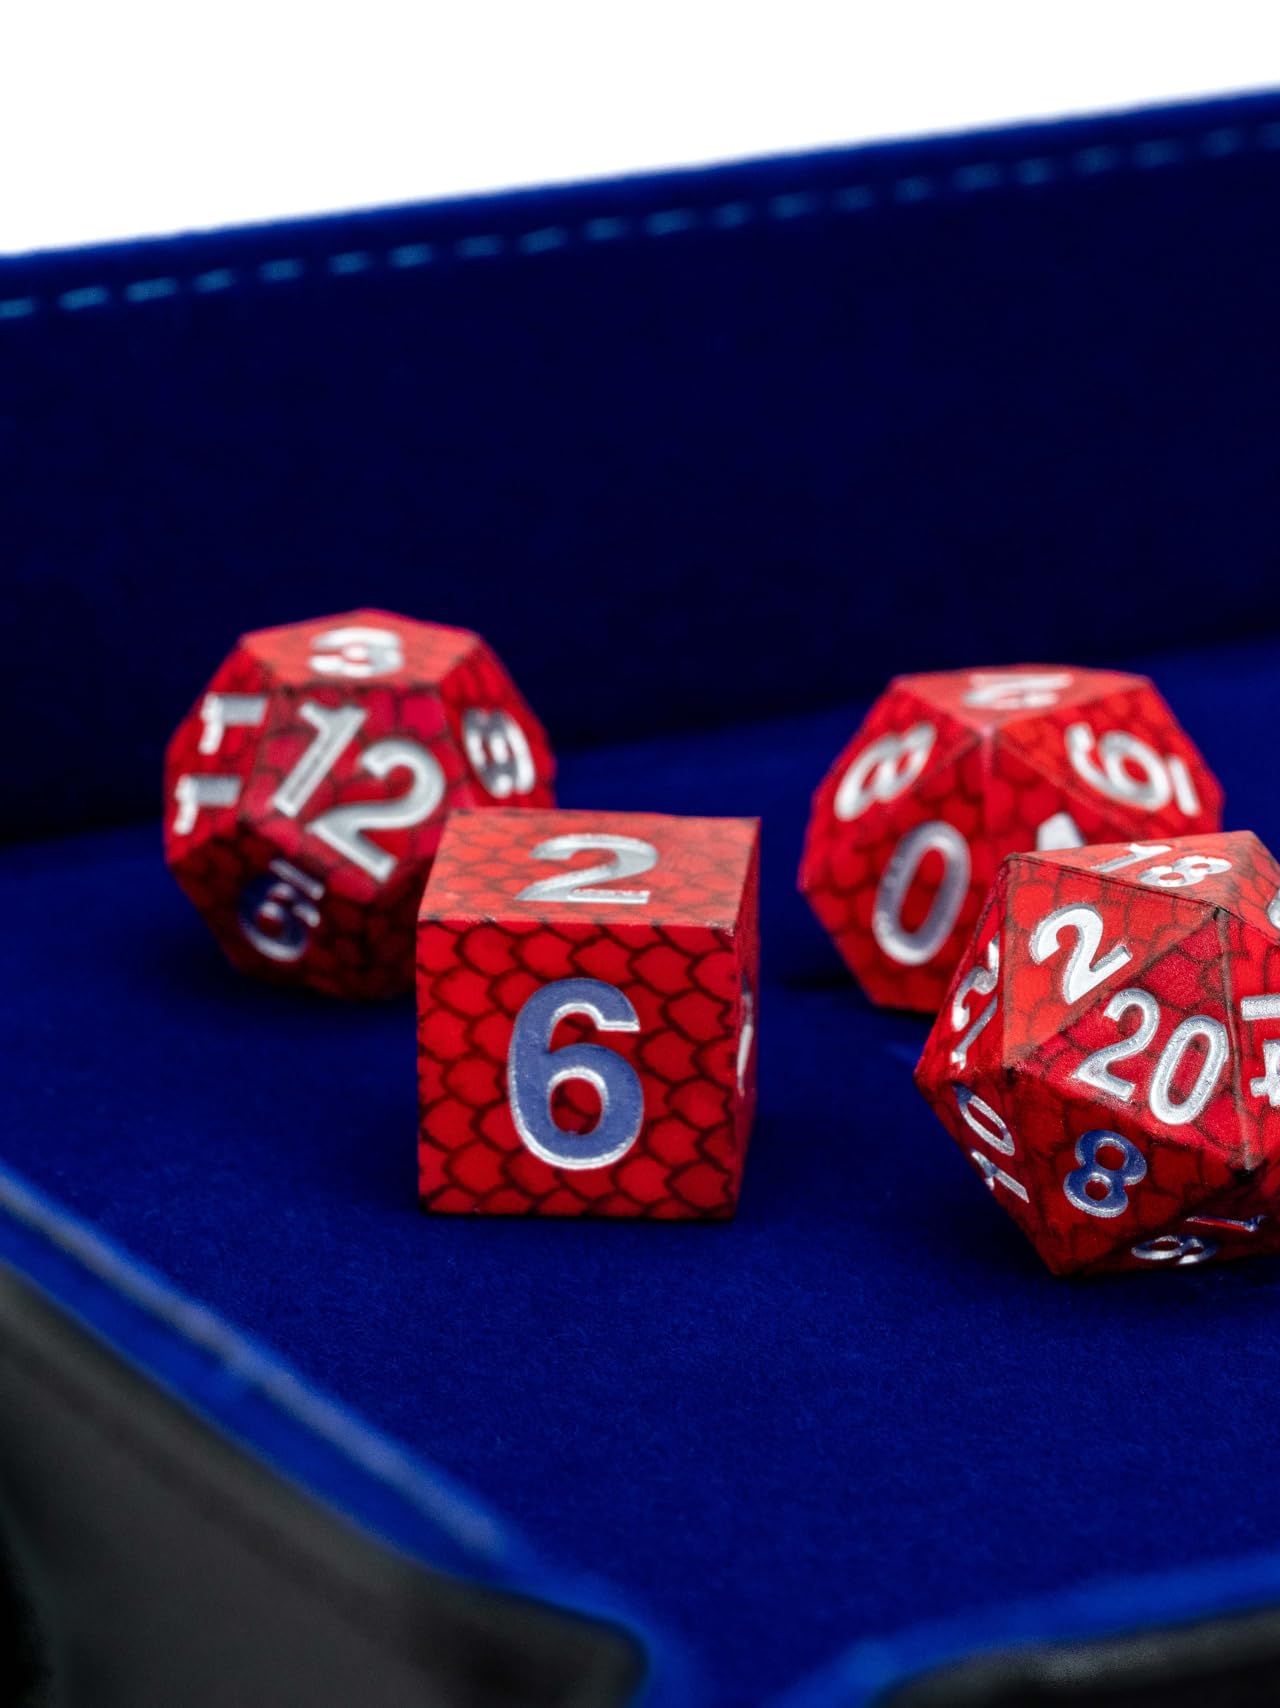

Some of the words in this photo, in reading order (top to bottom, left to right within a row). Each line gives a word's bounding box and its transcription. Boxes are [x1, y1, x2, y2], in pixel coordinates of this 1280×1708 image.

[272, 702, 446, 883] 12
[834, 721, 936, 821] 8
[515, 833, 660, 904] 2
[872, 820, 972, 967] 0
[1090, 843, 1233, 887] 18
[1028, 903, 1133, 1005] 2
[508, 978, 645, 1170] 6
[1073, 988, 1230, 1125] 20
[952, 1081, 1030, 1204] 10
[1063, 1130, 1147, 1228] 8
